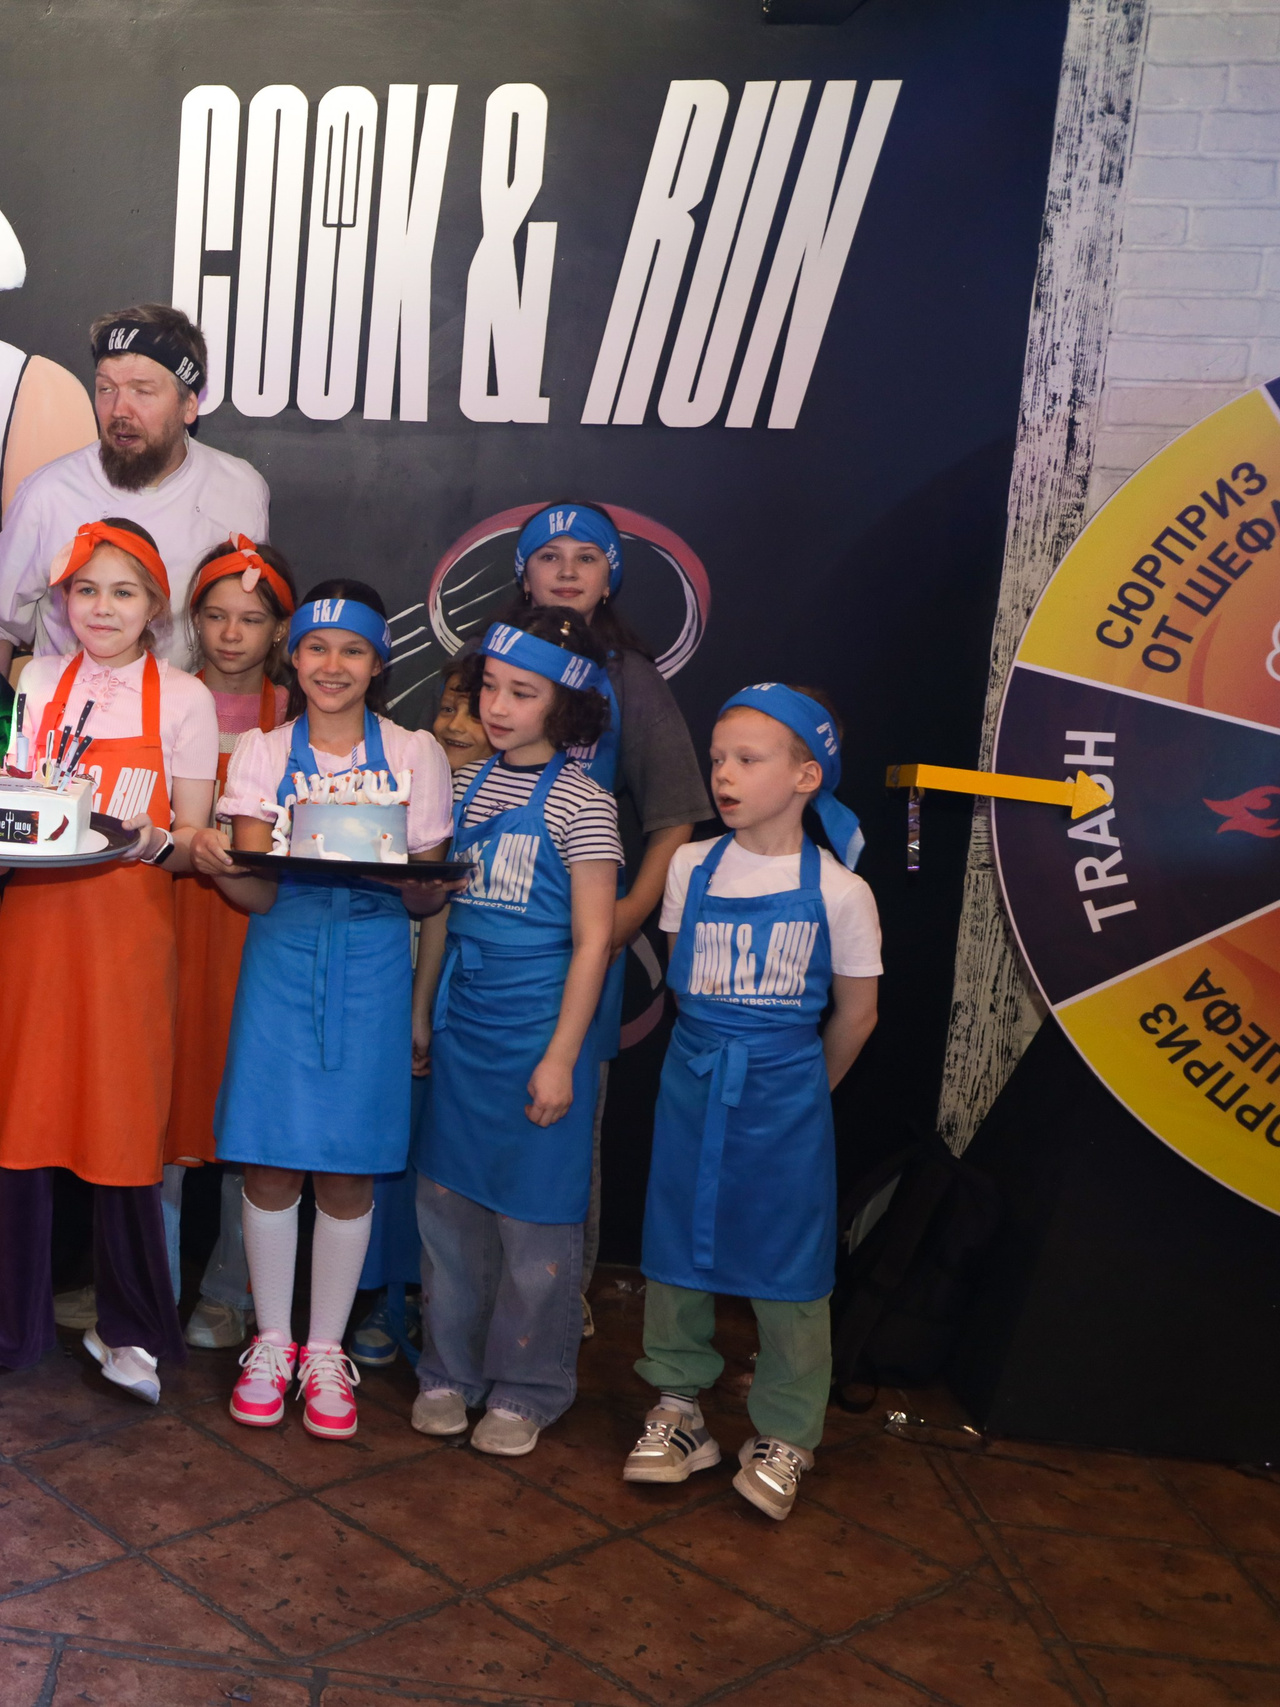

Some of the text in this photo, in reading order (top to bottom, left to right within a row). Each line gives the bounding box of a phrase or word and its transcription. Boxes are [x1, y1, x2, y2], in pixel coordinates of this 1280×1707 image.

[171, 79, 903, 429] COOK & RUN
[1096, 462, 1268, 649] СЮРПРИЗ
[1142, 499, 1280, 673] ОТ ШЕФ
[106, 767, 158, 821] RUN
[487, 833, 540, 903] RUN
[689, 921, 819, 996] OOK & RUN
[1139, 1003, 1280, 1147] РПРИЗ
